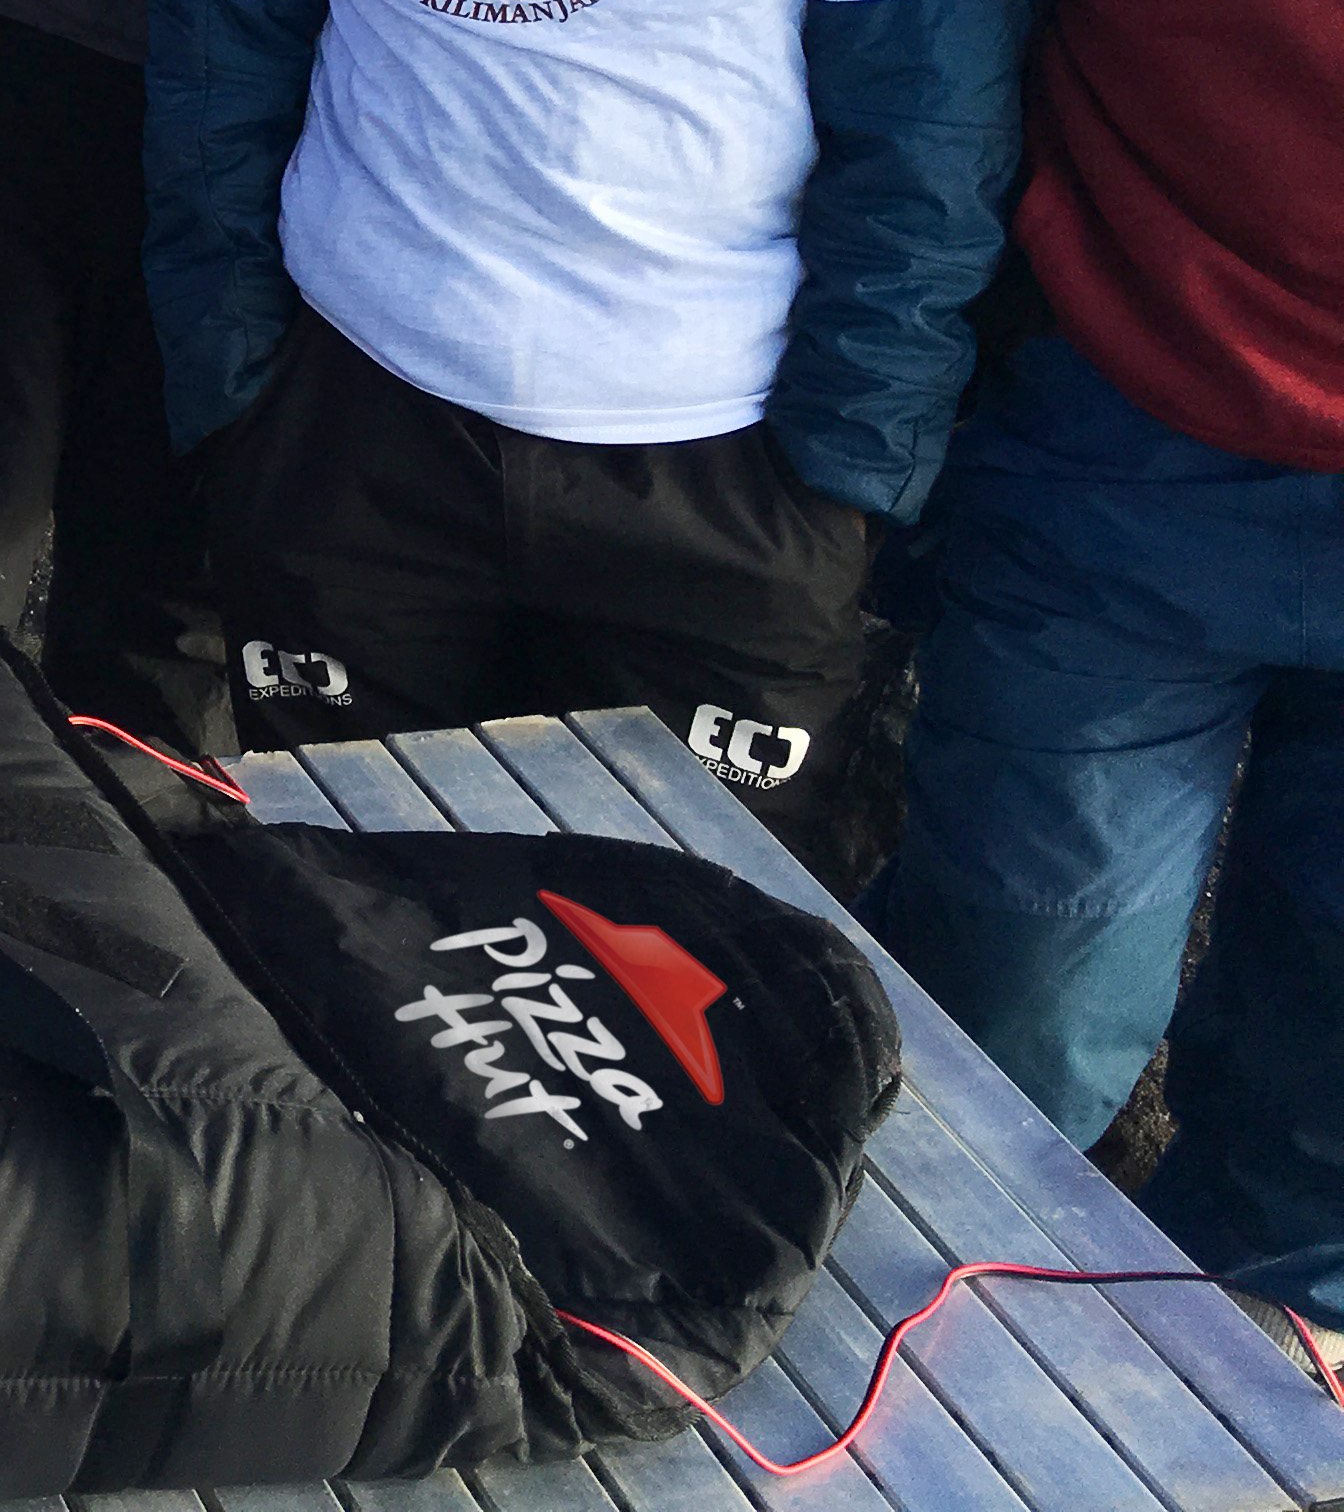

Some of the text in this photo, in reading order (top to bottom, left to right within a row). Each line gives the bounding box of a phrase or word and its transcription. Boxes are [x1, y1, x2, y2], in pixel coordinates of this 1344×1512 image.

[249, 684, 353, 706] EXPEDIONS
[394, 984, 589, 1142] Hut
[429, 916, 664, 1131] Pizza
